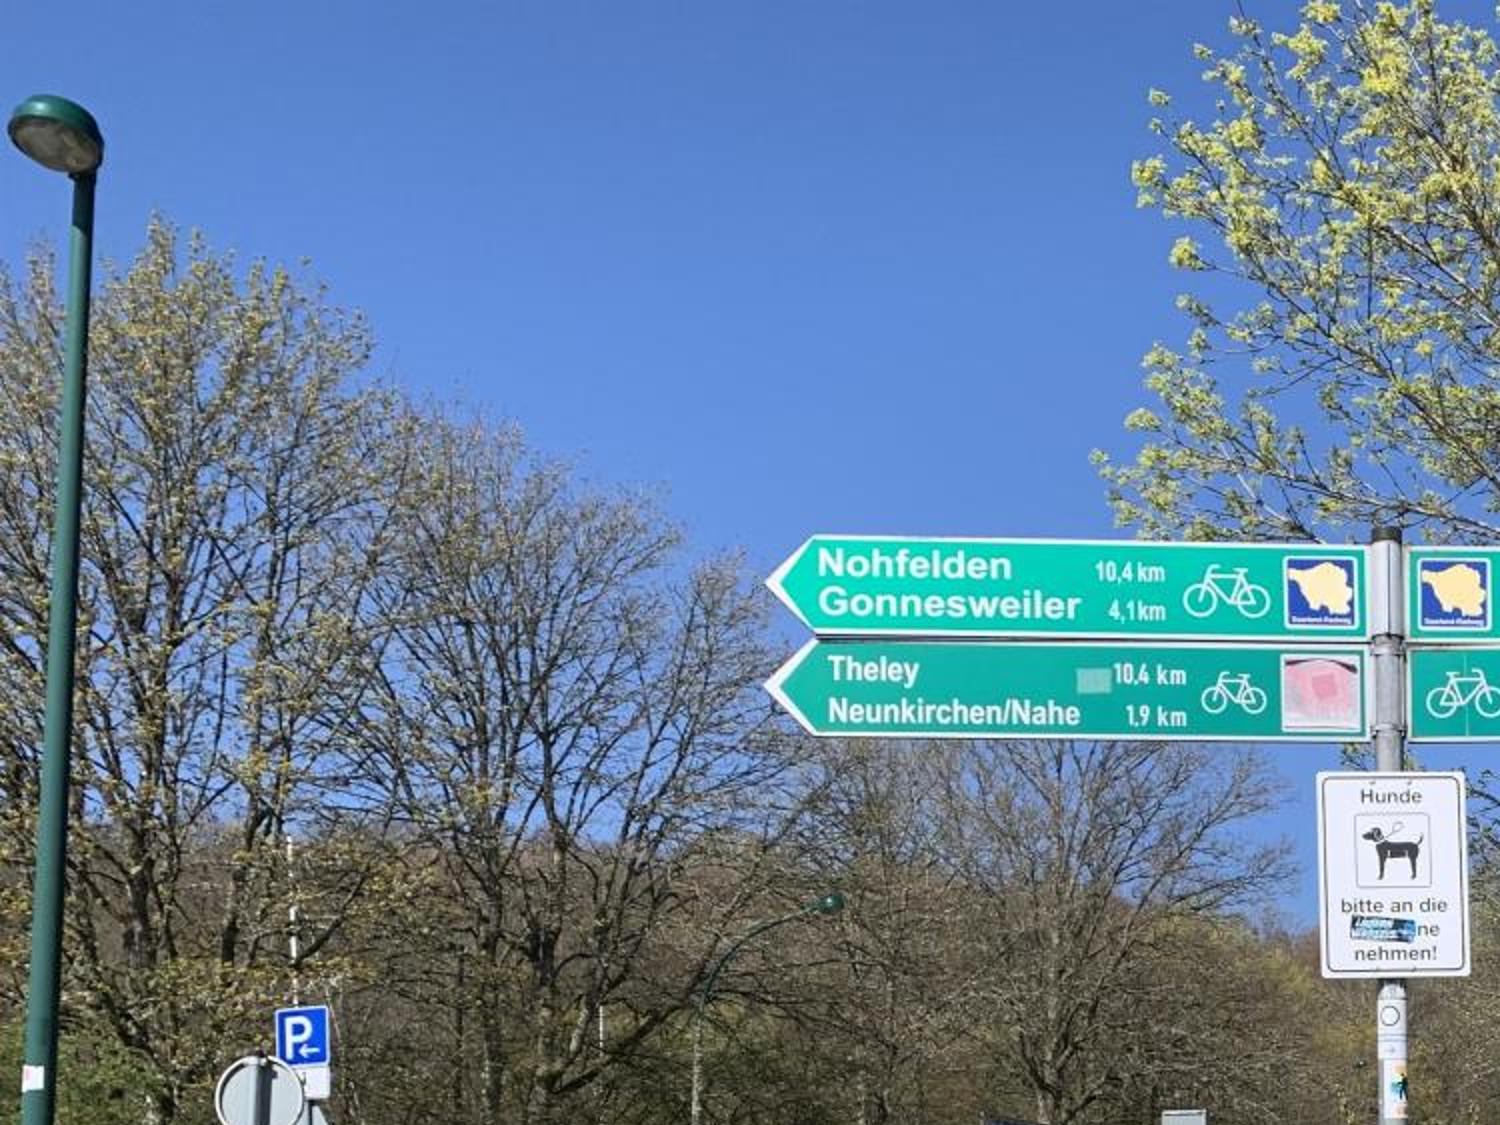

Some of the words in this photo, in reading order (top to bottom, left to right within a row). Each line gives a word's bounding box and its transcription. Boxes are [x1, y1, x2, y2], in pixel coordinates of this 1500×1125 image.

[818, 547, 1012, 580] Nohfelden
[1095, 560, 1134, 584] 10,4
[1137, 561, 1166, 582] km
[818, 586, 1082, 620] Gonnesweiler
[827, 654, 920, 690] Theley
[1156, 663, 1187, 685] km
[827, 695, 1081, 728] Neunkirchen/Nahe
[1156, 704, 1187, 727] km
[1360, 789, 1423, 804] Hunde
[1340, 900, 1385, 913] bitte
[1390, 901, 1414, 913] an
[1419, 898, 1448, 913] die
[1354, 945, 1437, 961] nehmen!
[284, 1015, 313, 1060] P
